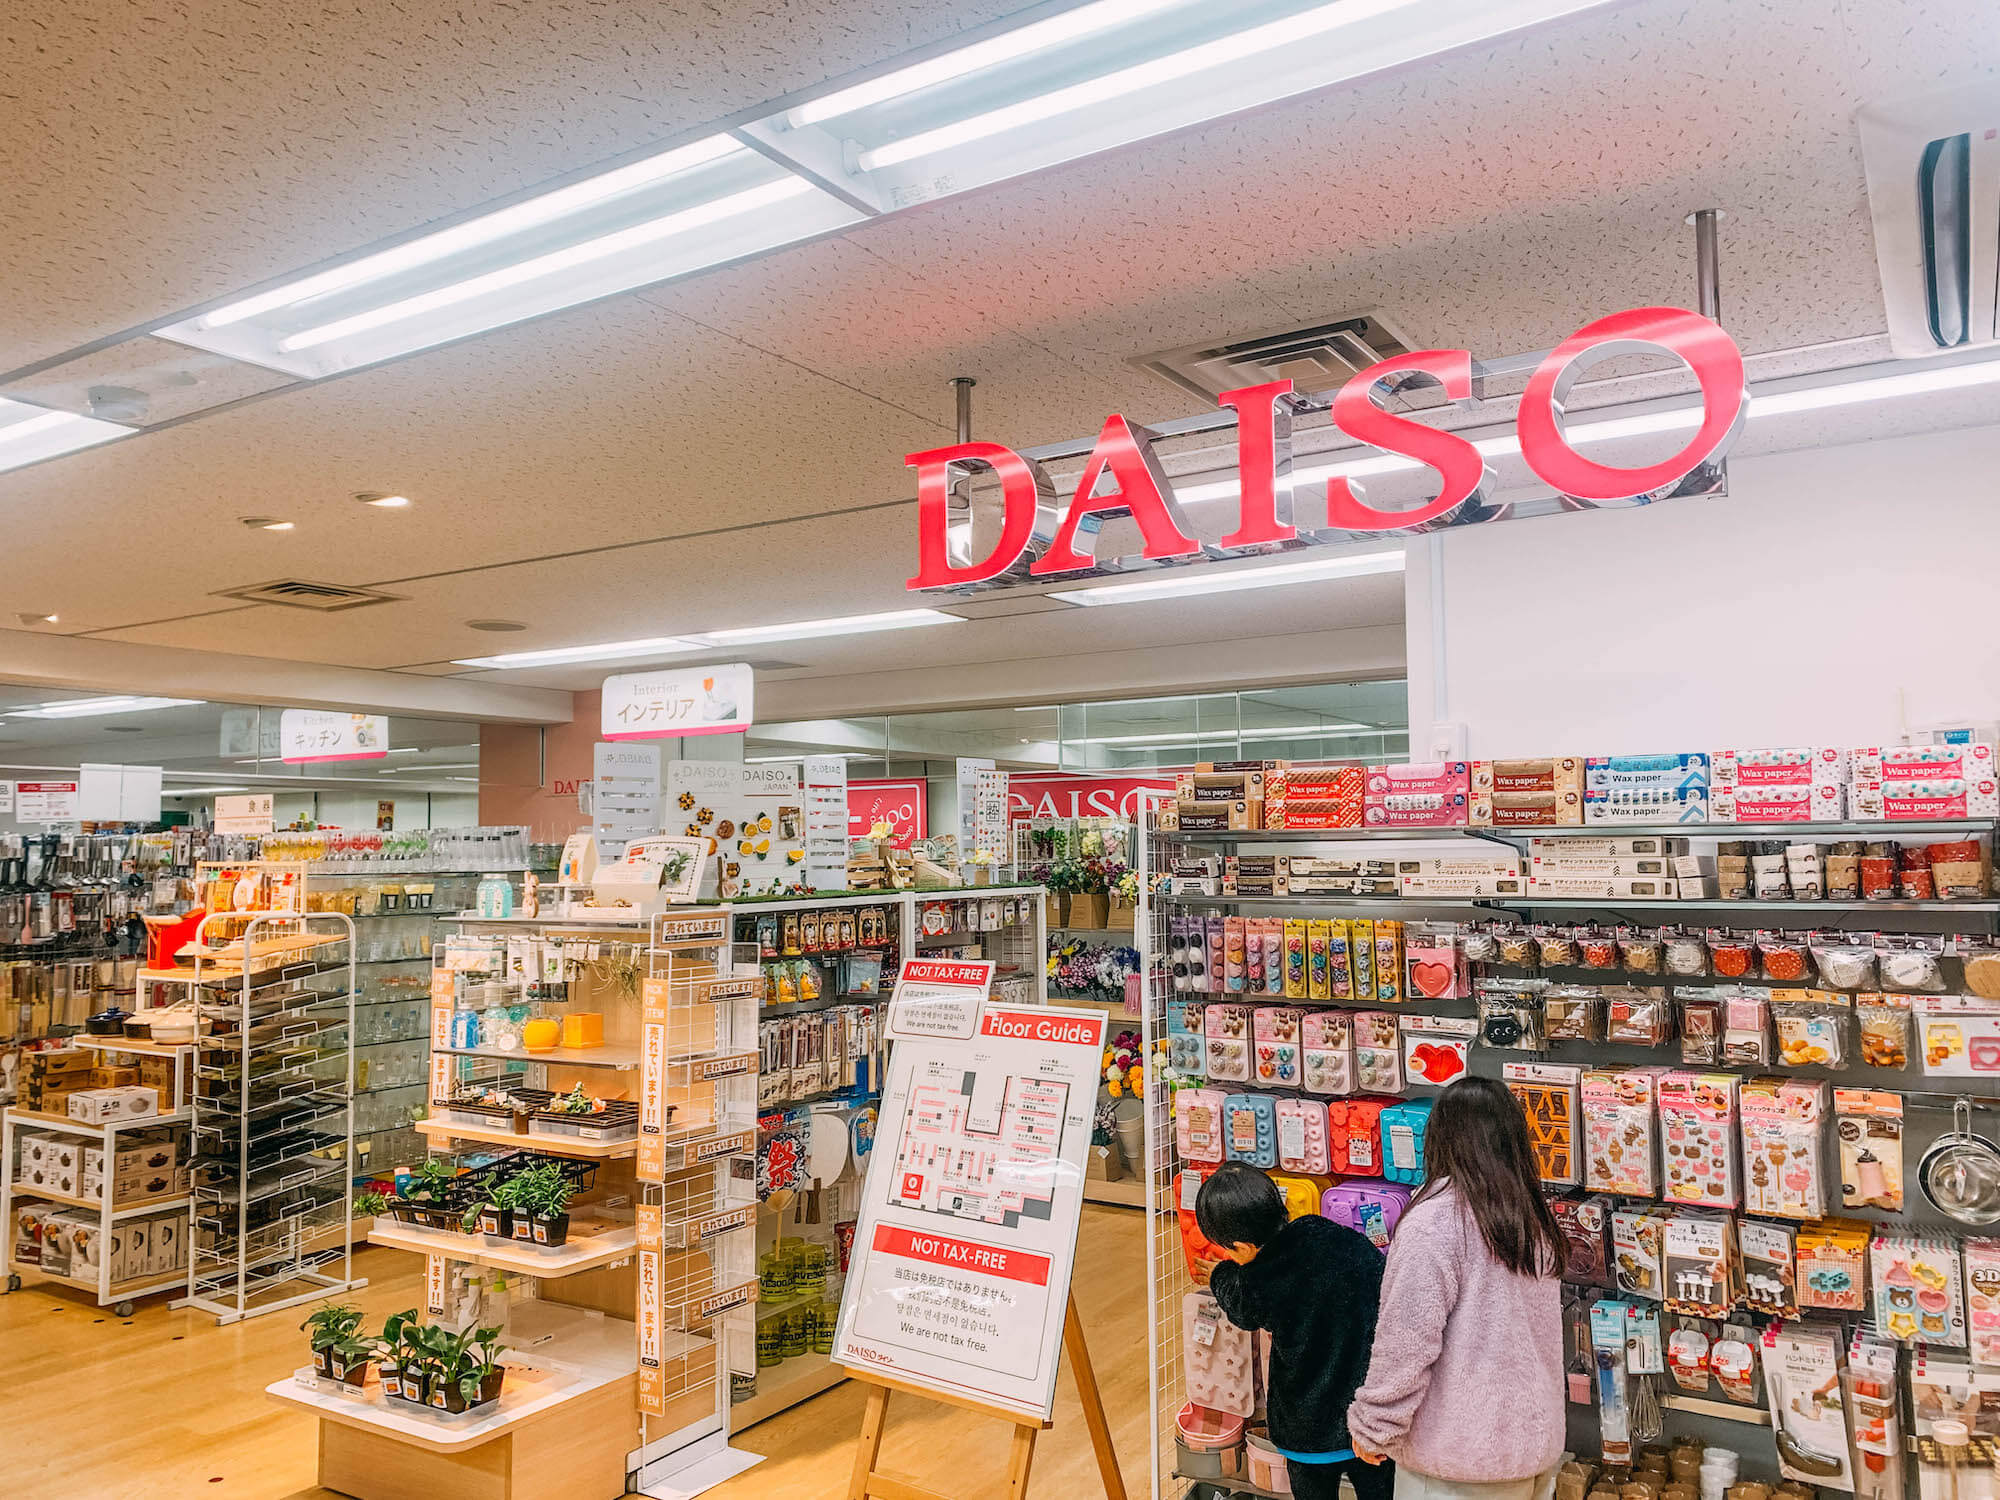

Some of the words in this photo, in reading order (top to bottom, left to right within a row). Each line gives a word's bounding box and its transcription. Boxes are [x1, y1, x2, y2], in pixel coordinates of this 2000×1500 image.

[905, 306, 1746, 592] DAISO
[633, 682, 680, 697] Interior
[617, 698, 695, 724] インテリア
[295, 730, 342, 748] キッチン
[743, 770, 785, 781] DAISO
[1765, 770, 1792, 779] paper
[1887, 767, 1909, 775] Wax
[1910, 767, 1942, 777] paper
[1497, 777, 1514, 785] Wax
[1515, 777, 1538, 787] paper
[1633, 775, 1661, 784] paper
[1306, 786, 1327, 795] paper
[1411, 781, 1436, 790] paper
[1197, 789, 1211, 797] Wax
[1212, 789, 1232, 799] paper
[1740, 806, 1761, 814] Wax
[1763, 806, 1791, 816] paper
[1889, 802, 1912, 810] Wax
[1914, 802, 1945, 812] paper
[1409, 812, 1434, 821] paper
[1496, 810, 1513, 818] Wax
[1515, 810, 1539, 820] paper
[1633, 808, 1660, 817] paper
[1196, 817, 1216, 826] paper
[1305, 816, 1327, 825] paper
[909, 965, 934, 978] NOT
[934, 966, 983, 981] TAX-FREE
[645, 984, 664, 994] PICK
[989, 1016, 1032, 1036] Floor
[1036, 1020, 1093, 1043] Guide
[911, 1236, 940, 1257] NOT
[941, 1242, 1007, 1271] TAX-FREE
[900, 1321, 915, 1335] We
[916, 1327, 931, 1338] are
[933, 1329, 948, 1342] not
[950, 1333, 965, 1346] tax
[966, 1336, 988, 1353] free.
[847, 1343, 877, 1360] DAISO
[639, 1369, 658, 1382] PICK
[639, 1394, 660, 1408] ITEM
